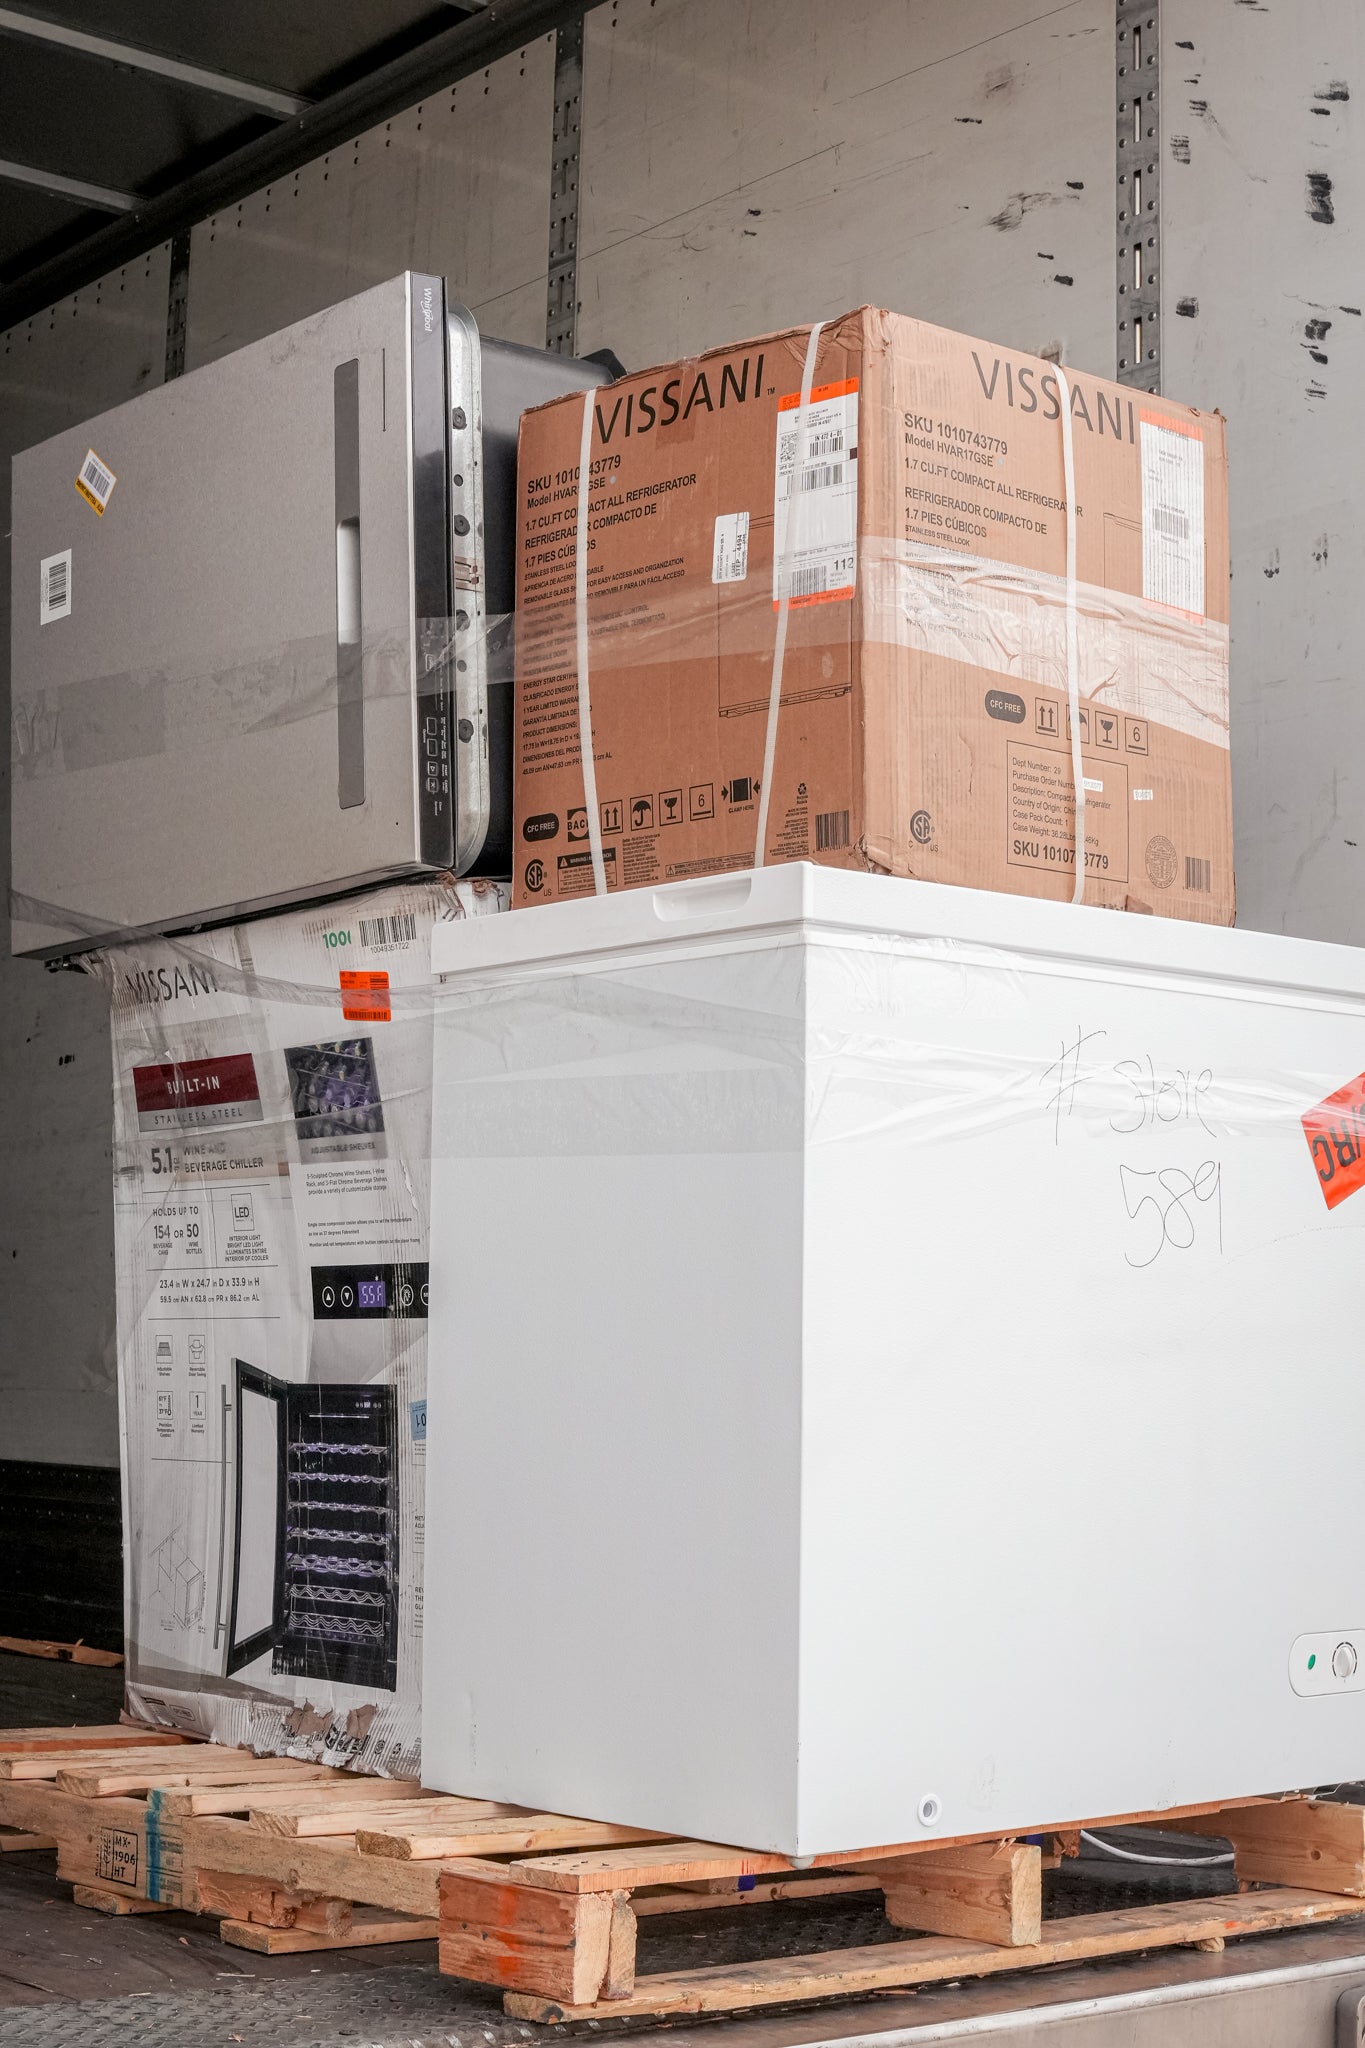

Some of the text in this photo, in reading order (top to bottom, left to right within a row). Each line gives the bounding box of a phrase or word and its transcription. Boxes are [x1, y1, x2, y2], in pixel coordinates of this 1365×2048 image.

[420, 287, 434, 332] Whirlpool
[595, 354, 765, 444] VISSANI
[971, 351, 1135, 445] VISSANI
[904, 412, 1008, 456] SKU 1010743779
[904, 432, 994, 467] Model HVAR17GSE
[527, 454, 621, 494] SKU 101043779
[904, 456, 1014, 498] 1.7 CU.FT COMPACT ALL
[527, 476, 606, 509] Model HVARGSE
[525, 473, 698, 532] 1.7 CU.FT COACT ALL REFRIGERATOR
[904, 486, 1047, 535] REFRIGERADOR COMPACTO DE
[525, 502, 657, 550] REFRIGERADR COMPACTO DE
[904, 507, 987, 538] 1.7 PIES CÚBICOS
[905, 524, 970, 547] STAINLESS STEEL LOOK
[524, 549, 556, 568] 1.7 PIES
[833, 557, 854, 571] 112
[524, 561, 577, 580] STAINLESS STEEL LOO
[587, 579, 598, 588] FOR
[598, 575, 611, 586] EASY
[611, 571, 633, 583] ACCESS
[632, 567, 644, 576] AND
[645, 557, 684, 574] ORGANIZATION
[662, 569, 685, 582] ACCESO
[524, 573, 574, 593] APRIENCIA ACERO
[523, 592, 553, 605] REMOVABLE
[554, 586, 570, 597] GLASS
[523, 675, 555, 690] ENERGY STAR
[523, 685, 575, 702] CLASIFICADO ENERGY
[526, 700, 559, 714] YEAR LIMITED
[547, 709, 569, 721] LIMITADA
[569, 708, 577, 716] DE
[989, 698, 1022, 715] CFC FREE
[522, 727, 546, 739] PRODUCT
[1132, 726, 1141, 742] 6
[522, 748, 565, 763] DIMENSIONES DEL
[605, 751, 613, 759] AL
[1012, 757, 1052, 773] Dept Number:
[1012, 770, 1056, 787] Purchase Order
[698, 793, 705, 808] 6
[1012, 796, 1036, 810] Country
[1047, 790, 1071, 804] Compact
[743, 803, 755, 813] HERE
[1012, 809, 1028, 820] Case
[1028, 812, 1044, 823] Pack
[526, 820, 556, 834] CFC FREE
[1012, 822, 1028, 834] Case
[929, 843, 939, 853] US
[1013, 839, 1108, 870] SKU 101073779
[543, 887, 552, 897] US
[125, 963, 218, 1004] VISSANI
[166, 1075, 220, 1095] BUILT-IN
[1109, 1054, 1217, 1138] Store
[154, 1107, 243, 1125] STAINLESS STEEL
[183, 1142, 226, 1156] WINE AND
[349, 1141, 376, 1152] SHELVES
[151, 1147, 174, 1175] 5.1
[184, 1157, 264, 1173] BEVERAGE CHILLER
[328, 1169, 344, 1178] Chrome
[337, 1178, 354, 1186] Chrome
[354, 1177, 373, 1186] Beverage
[308, 1188, 323, 1197] provide
[327, 1187, 341, 1195] variety
[346, 1185, 373, 1194] customizable
[153, 1206, 198, 1217] HOLDS UP TO
[234, 1206, 249, 1218] LED
[1120, 1160, 1222, 1268] 589
[153, 1223, 199, 1240] 154 OR 50
[159, 1277, 261, 1289] 23.4 W 24.7 D 33.9 H
[160, 1293, 260, 1304] 59.5 AN PR AL
[115, 1834, 131, 1848] MX-
[114, 1851, 137, 1866] 1906
[114, 1866, 126, 1878] HT
